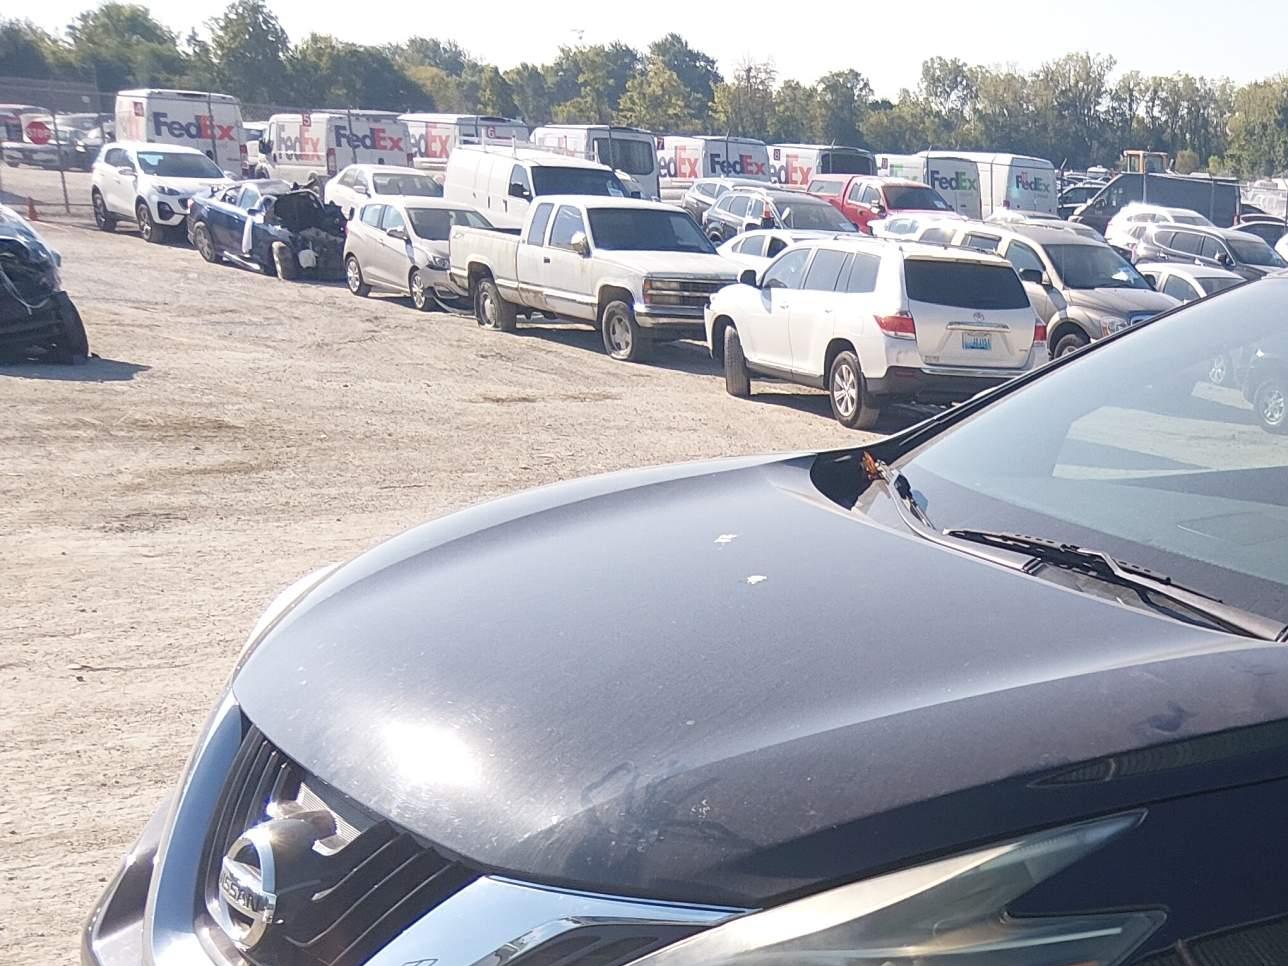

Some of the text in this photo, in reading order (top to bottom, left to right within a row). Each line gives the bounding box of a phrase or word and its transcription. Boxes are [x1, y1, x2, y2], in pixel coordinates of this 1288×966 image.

[153, 112, 236, 140] FedEx
[302, 113, 311, 125] 5
[25, 127, 51, 139] STOP
[334, 125, 404, 152] FedEx
[659, 146, 699, 178] edEx
[710, 153, 766, 176] FedEx
[770, 154, 813, 185] edEx
[930, 170, 977, 191] FedEx
[1015, 174, 1050, 193] FedEx
